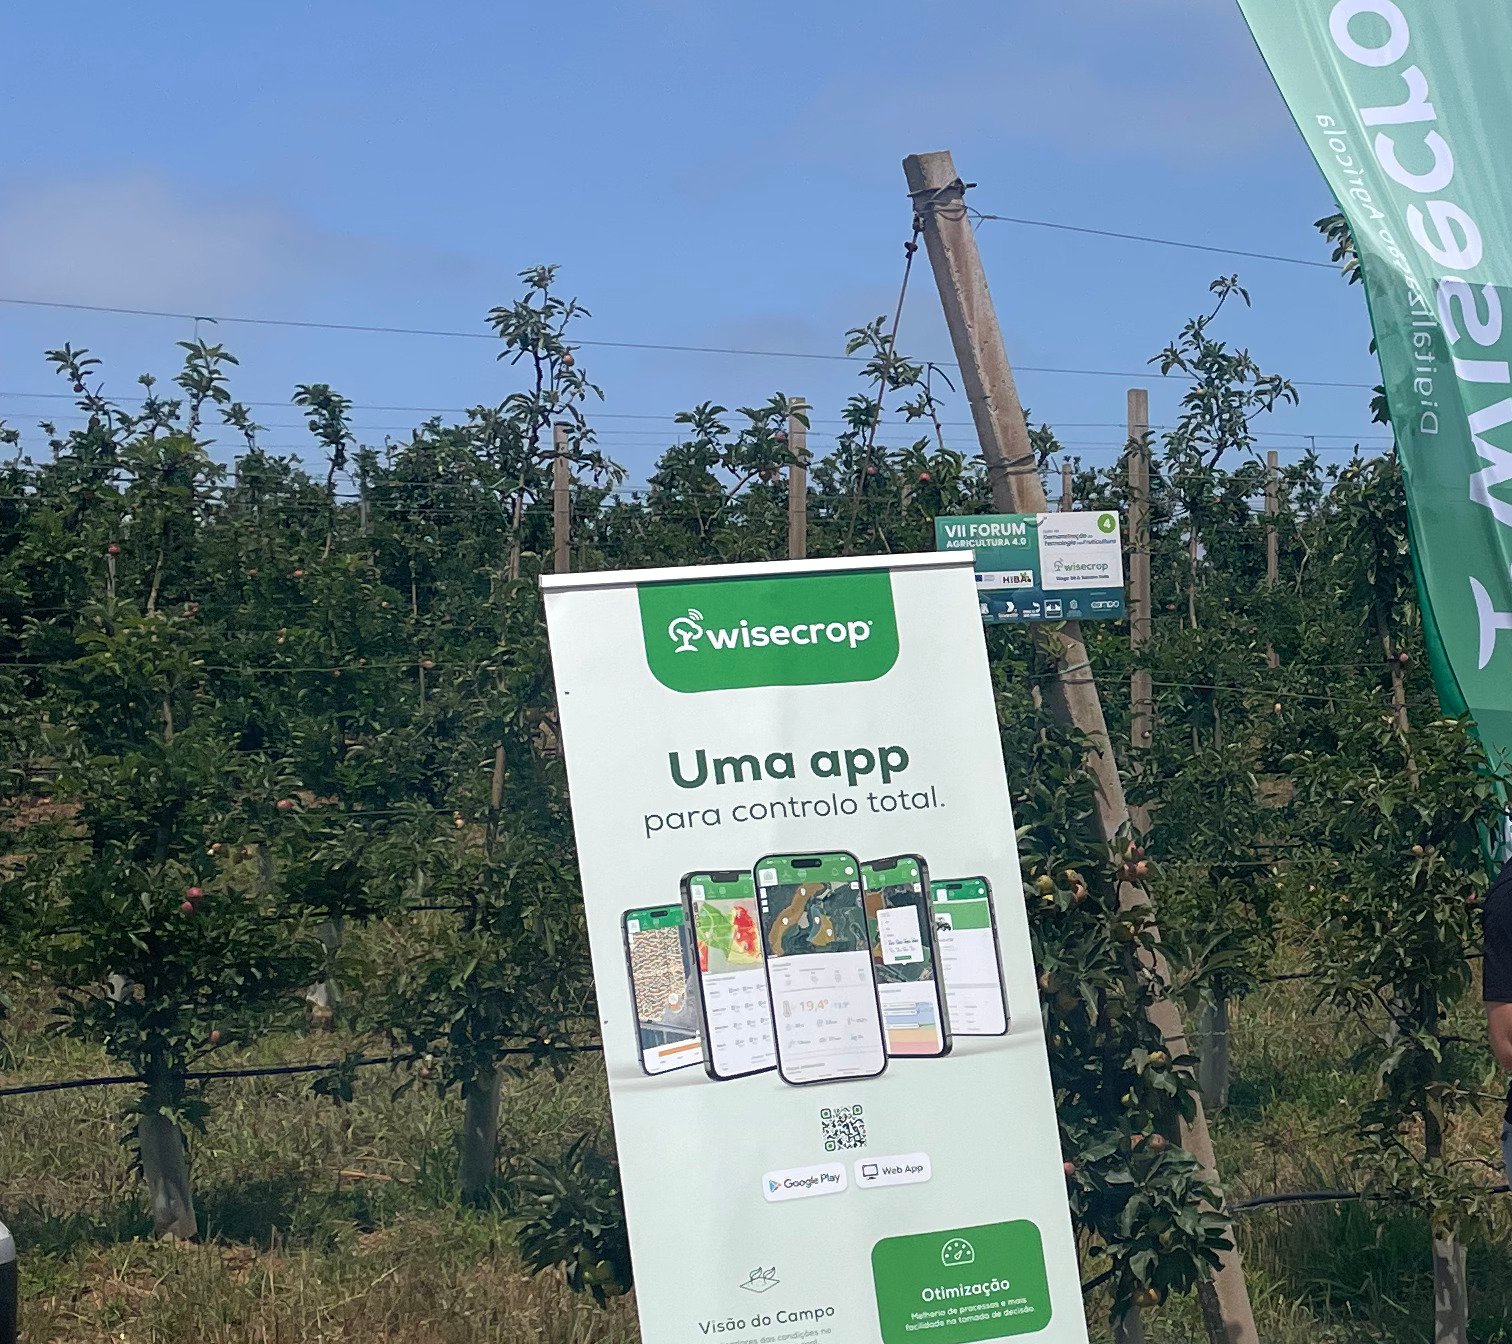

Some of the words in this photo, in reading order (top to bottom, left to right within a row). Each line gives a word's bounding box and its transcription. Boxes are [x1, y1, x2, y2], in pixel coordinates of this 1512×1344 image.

[944, 524, 967, 538] VII
[970, 522, 1026, 537] FORUM
[1103, 518, 1111, 529] 4
[946, 538, 1010, 548] AGRICULTURA
[1012, 537, 1027, 546] 4.0
[1064, 562, 1109, 572] wisecrop
[706, 619, 871, 649] wisecrop
[668, 749, 796, 789] Uma
[810, 745, 909, 787] app
[644, 807, 721, 839] para
[732, 793, 858, 822] controlo
[867, 785, 945, 813] total.
[882, 1166, 903, 1175] Web
[904, 1164, 924, 1174] App
[783, 1176, 819, 1189] Google
[820, 1173, 841, 1185] Play
[921, 1278, 1010, 1302] Otimização
[699, 1318, 746, 1335] Visão
[751, 1314, 771, 1328] do
[776, 1307, 835, 1324] Campo
